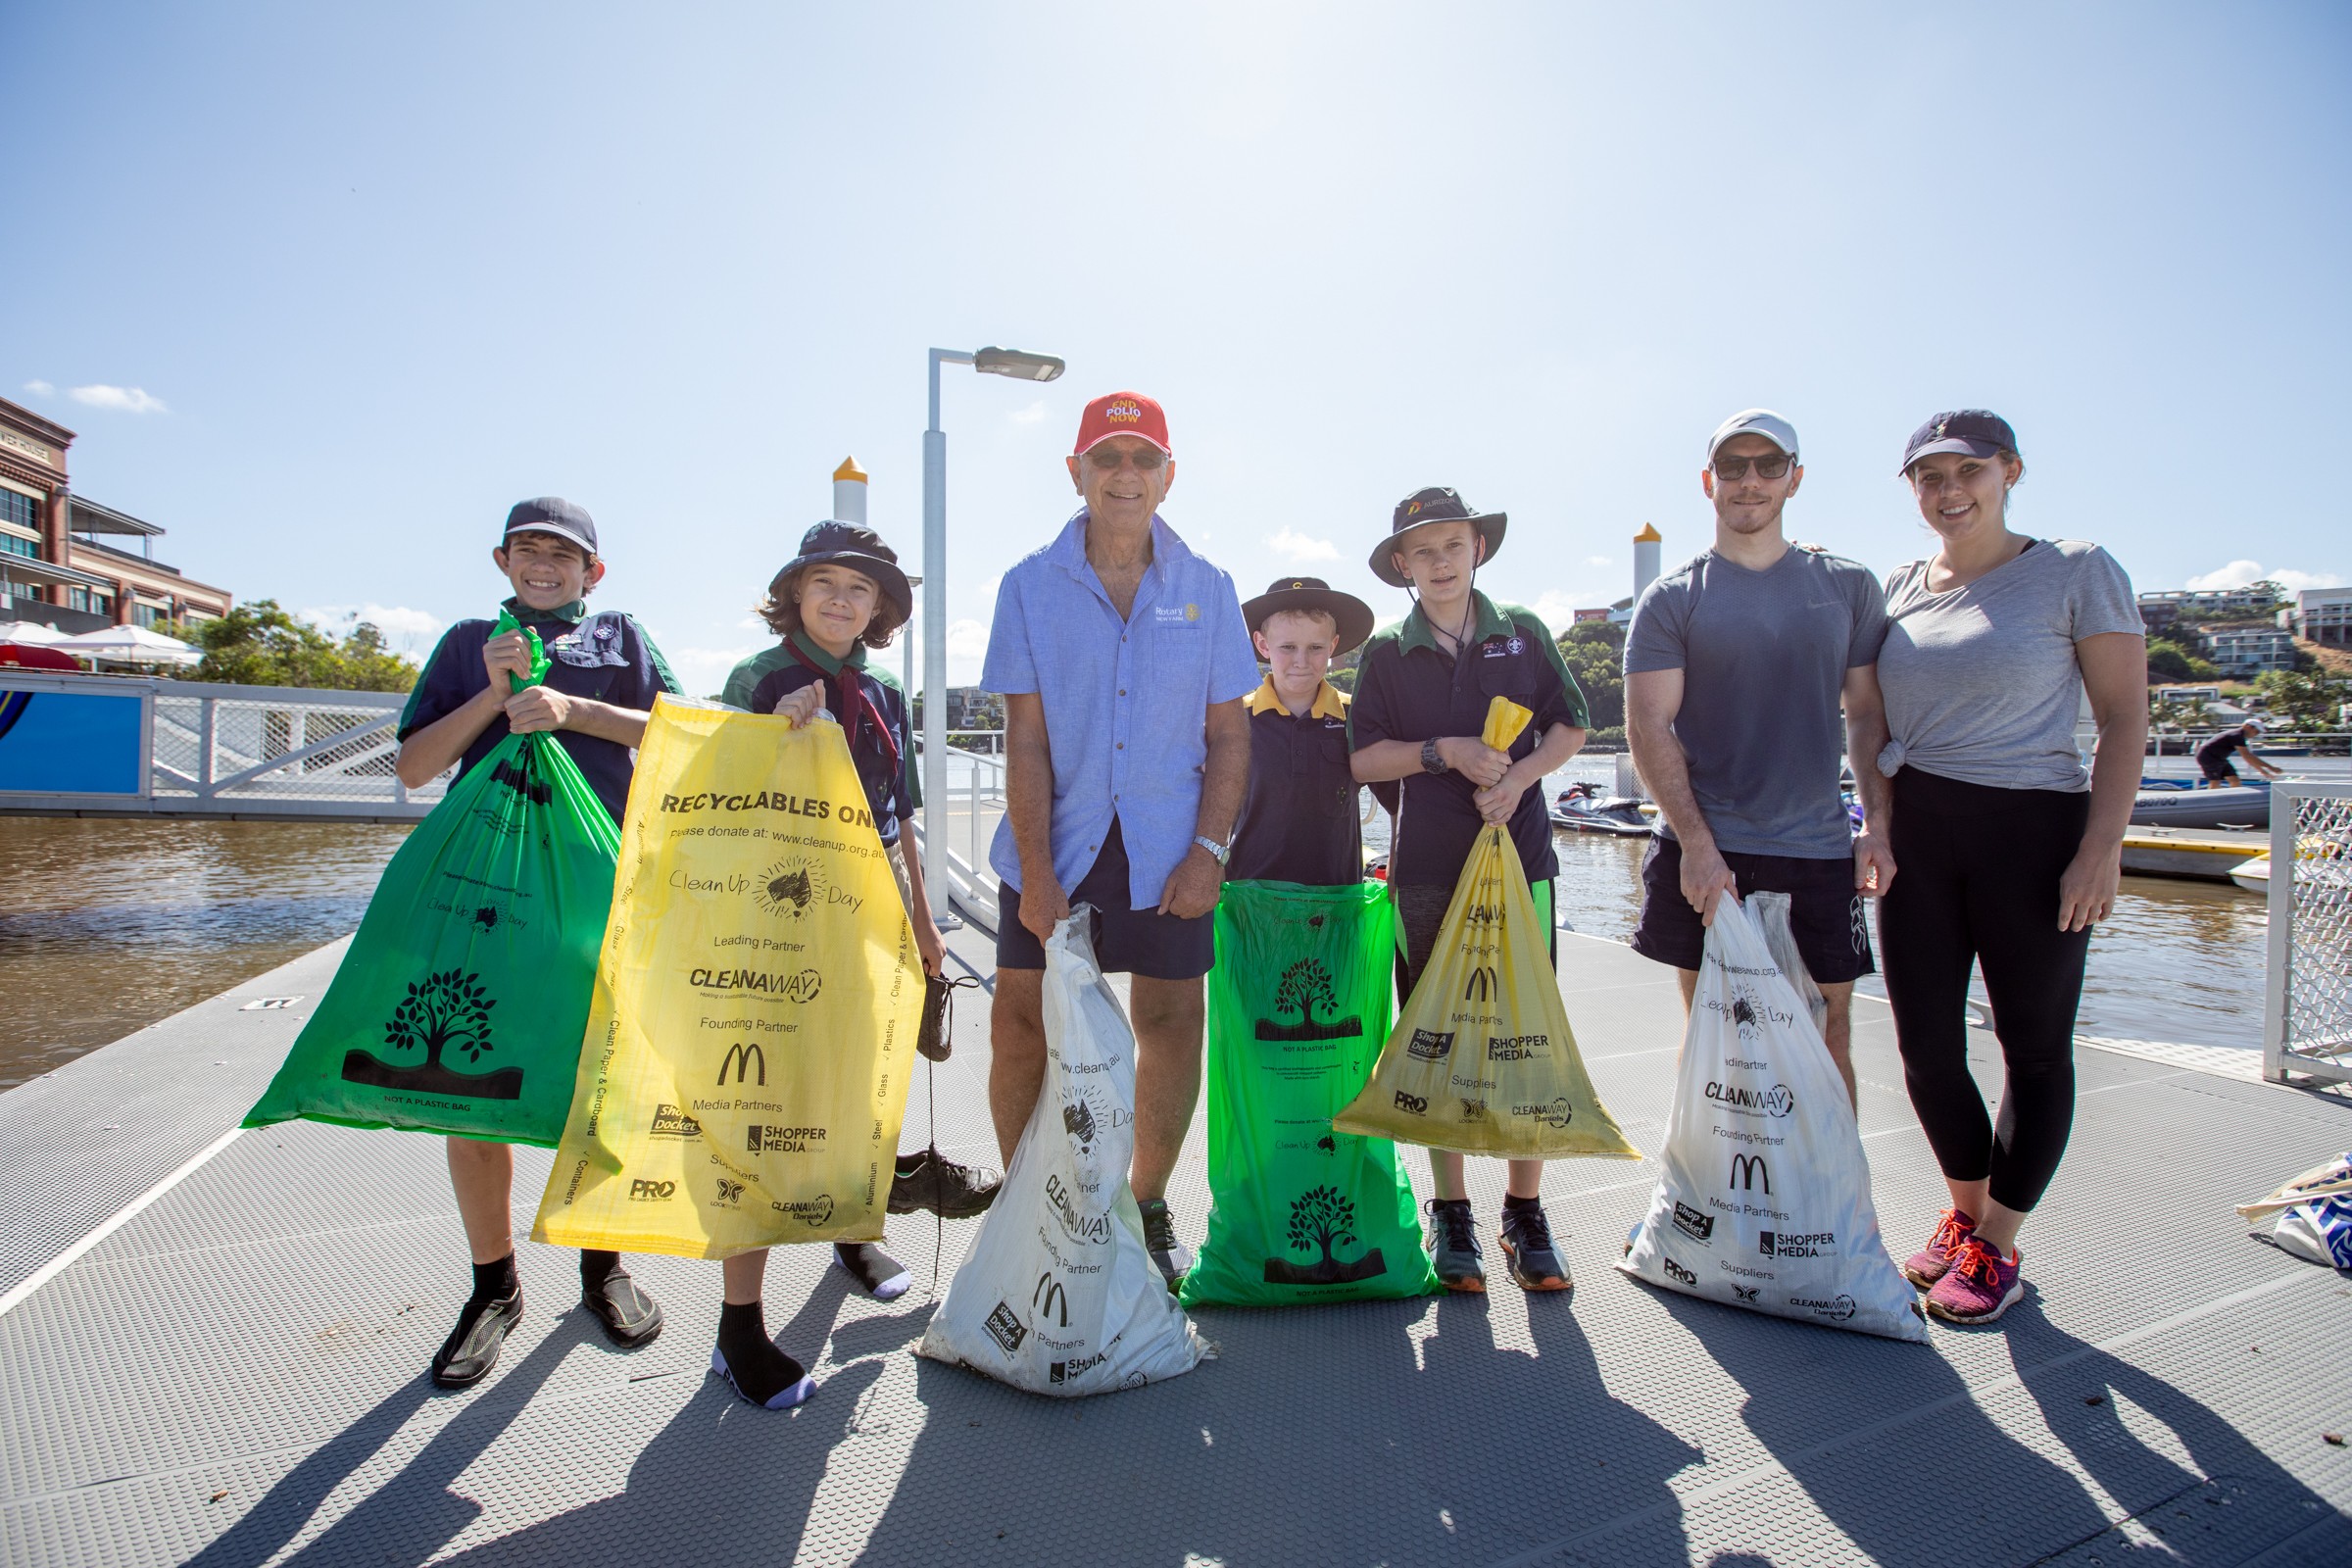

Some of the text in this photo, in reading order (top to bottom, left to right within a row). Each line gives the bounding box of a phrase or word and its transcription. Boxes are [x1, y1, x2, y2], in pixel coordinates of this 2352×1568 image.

[1106, 407, 1141, 417] POLIO
[1112, 400, 1137, 409] END
[1109, 414, 1138, 423] NOW
[1424, 498, 1454, 509] AURIZON
[1156, 607, 1183, 615] Rotary
[660, 791, 878, 830] RECYCLABLES ON
[708, 826, 749, 837] donate
[753, 826, 768, 838] at:
[772, 832, 886, 858] www.cleanup.org.au
[669, 869, 863, 914] Clean Up Day
[427, 898, 527, 930] Clea Up Day
[612, 925, 624, 950] Glass
[714, 934, 806, 952] Leading Partner
[895, 952, 906, 973] Paper
[689, 967, 814, 995] CLEANAWAY
[891, 974, 902, 997] Clean
[701, 1017, 798, 1033] Founding Partner
[1451, 1013, 1475, 1024] Mdia
[609, 1020, 620, 1047] Clean
[883, 1018, 896, 1052] Plastics
[1440, 1035, 1446, 1044] A
[1494, 1035, 1548, 1049] SHOPPER
[600, 1049, 614, 1076] Paper
[1494, 1050, 1533, 1061] MEDIA
[877, 1073, 888, 1098] Glass
[415, 1099, 450, 1108] PLASTIC
[693, 1100, 783, 1112] Media Partners
[1395, 1090, 1428, 1112] PRO
[1512, 1103, 1567, 1115] CLEANAWAY
[587, 1089, 607, 1137] Cardboard
[1113, 1107, 1134, 1128] Da
[655, 1119, 697, 1131] Docket
[764, 1125, 826, 1140] SHOPPER
[872, 1119, 883, 1141] Steel
[763, 1139, 807, 1152] MEDIA
[1275, 1137, 1358, 1150] Clean Up Day
[564, 1160, 588, 1205] Containers
[630, 1178, 675, 1198] PRO
[865, 1161, 877, 1206] Aluminium
[771, 1200, 830, 1212] CLEANAWAY
[1677, 1205, 1700, 1221] Shop
[1709, 1197, 1789, 1221] Media Partners
[1777, 1233, 1836, 1246] SHOPPER
[1778, 1246, 1819, 1257] MEDIA
[1062, 1257, 1102, 1274] Partner
[1664, 1257, 1697, 1285] PRO
[1721, 1260, 1775, 1280] Suppliers
[1790, 1298, 1850, 1309] CLEANAWAY
[998, 1306, 1017, 1328] Shop
[990, 1315, 1016, 1346] Docket
[1037, 1332, 1085, 1350] Partners
